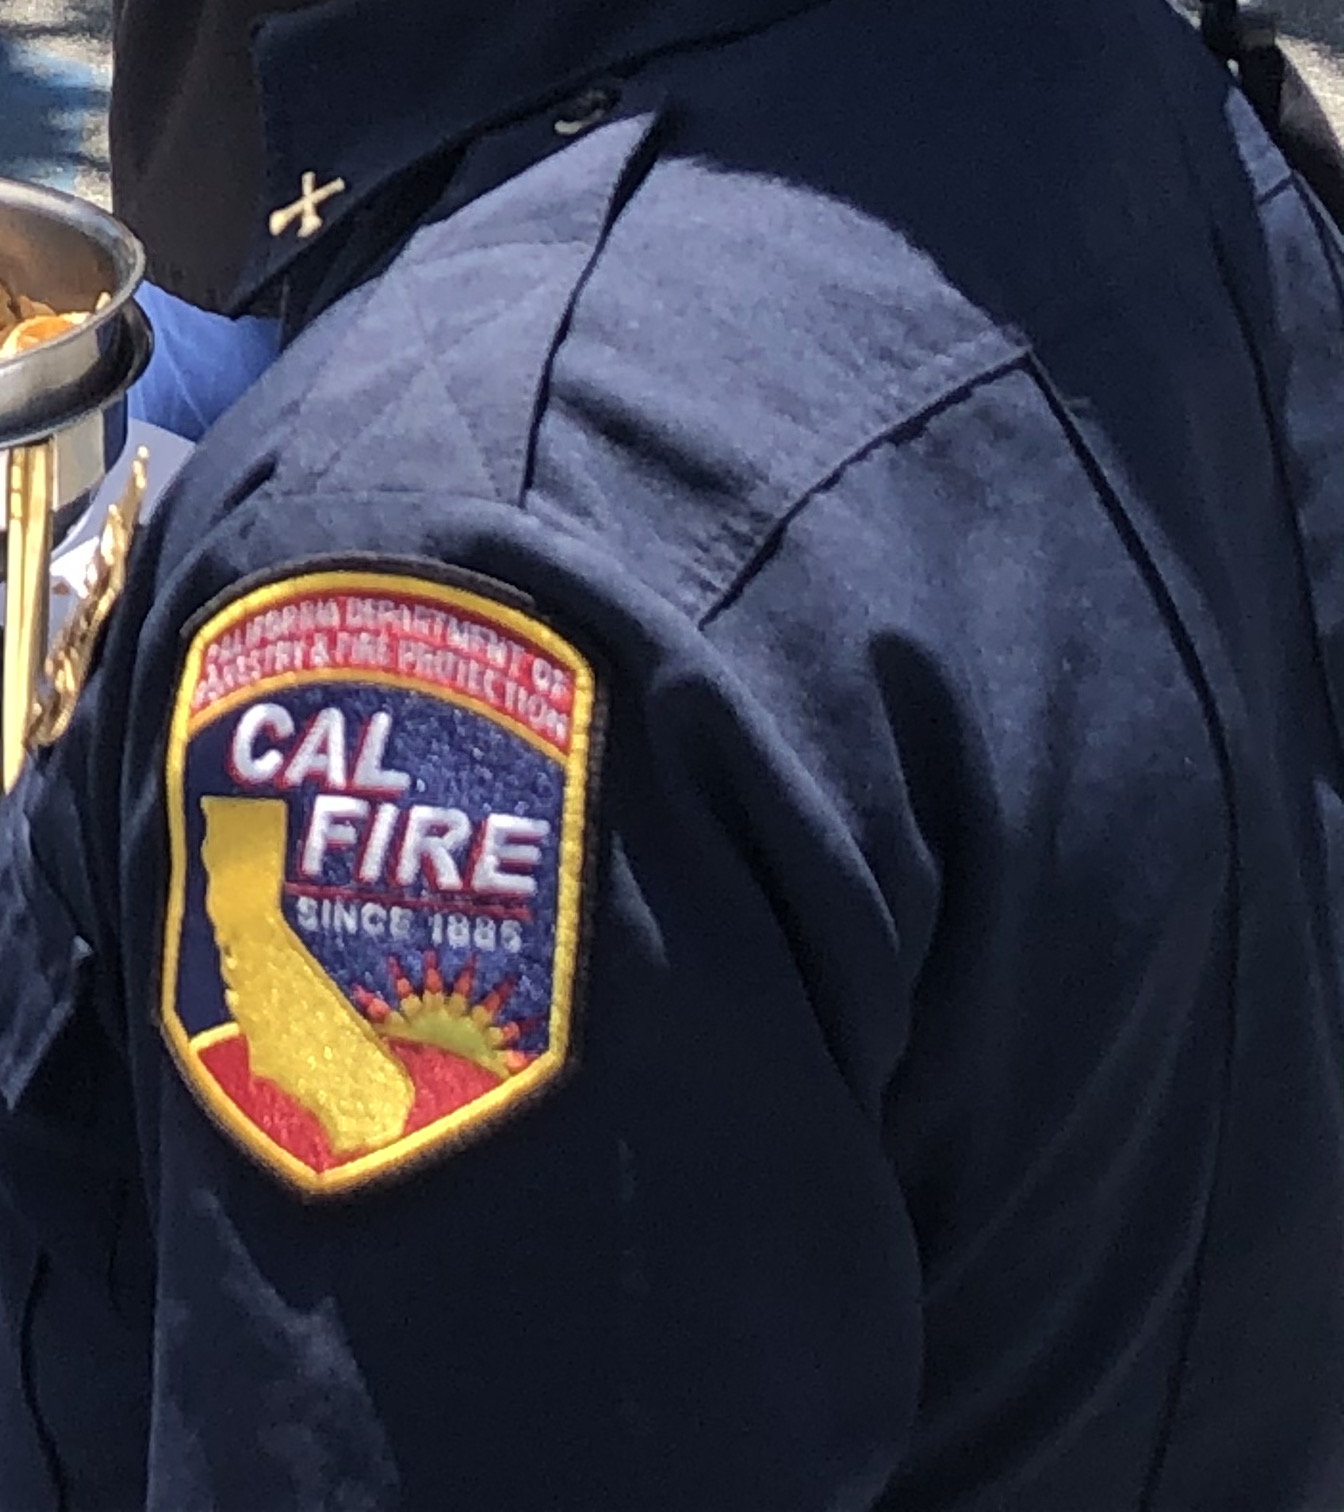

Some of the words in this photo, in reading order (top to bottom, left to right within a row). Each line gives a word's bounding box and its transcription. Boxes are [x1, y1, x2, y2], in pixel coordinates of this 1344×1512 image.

[232, 702, 411, 790] CAL
[299, 794, 552, 895] FIRE
[296, 895, 413, 939] SINCE
